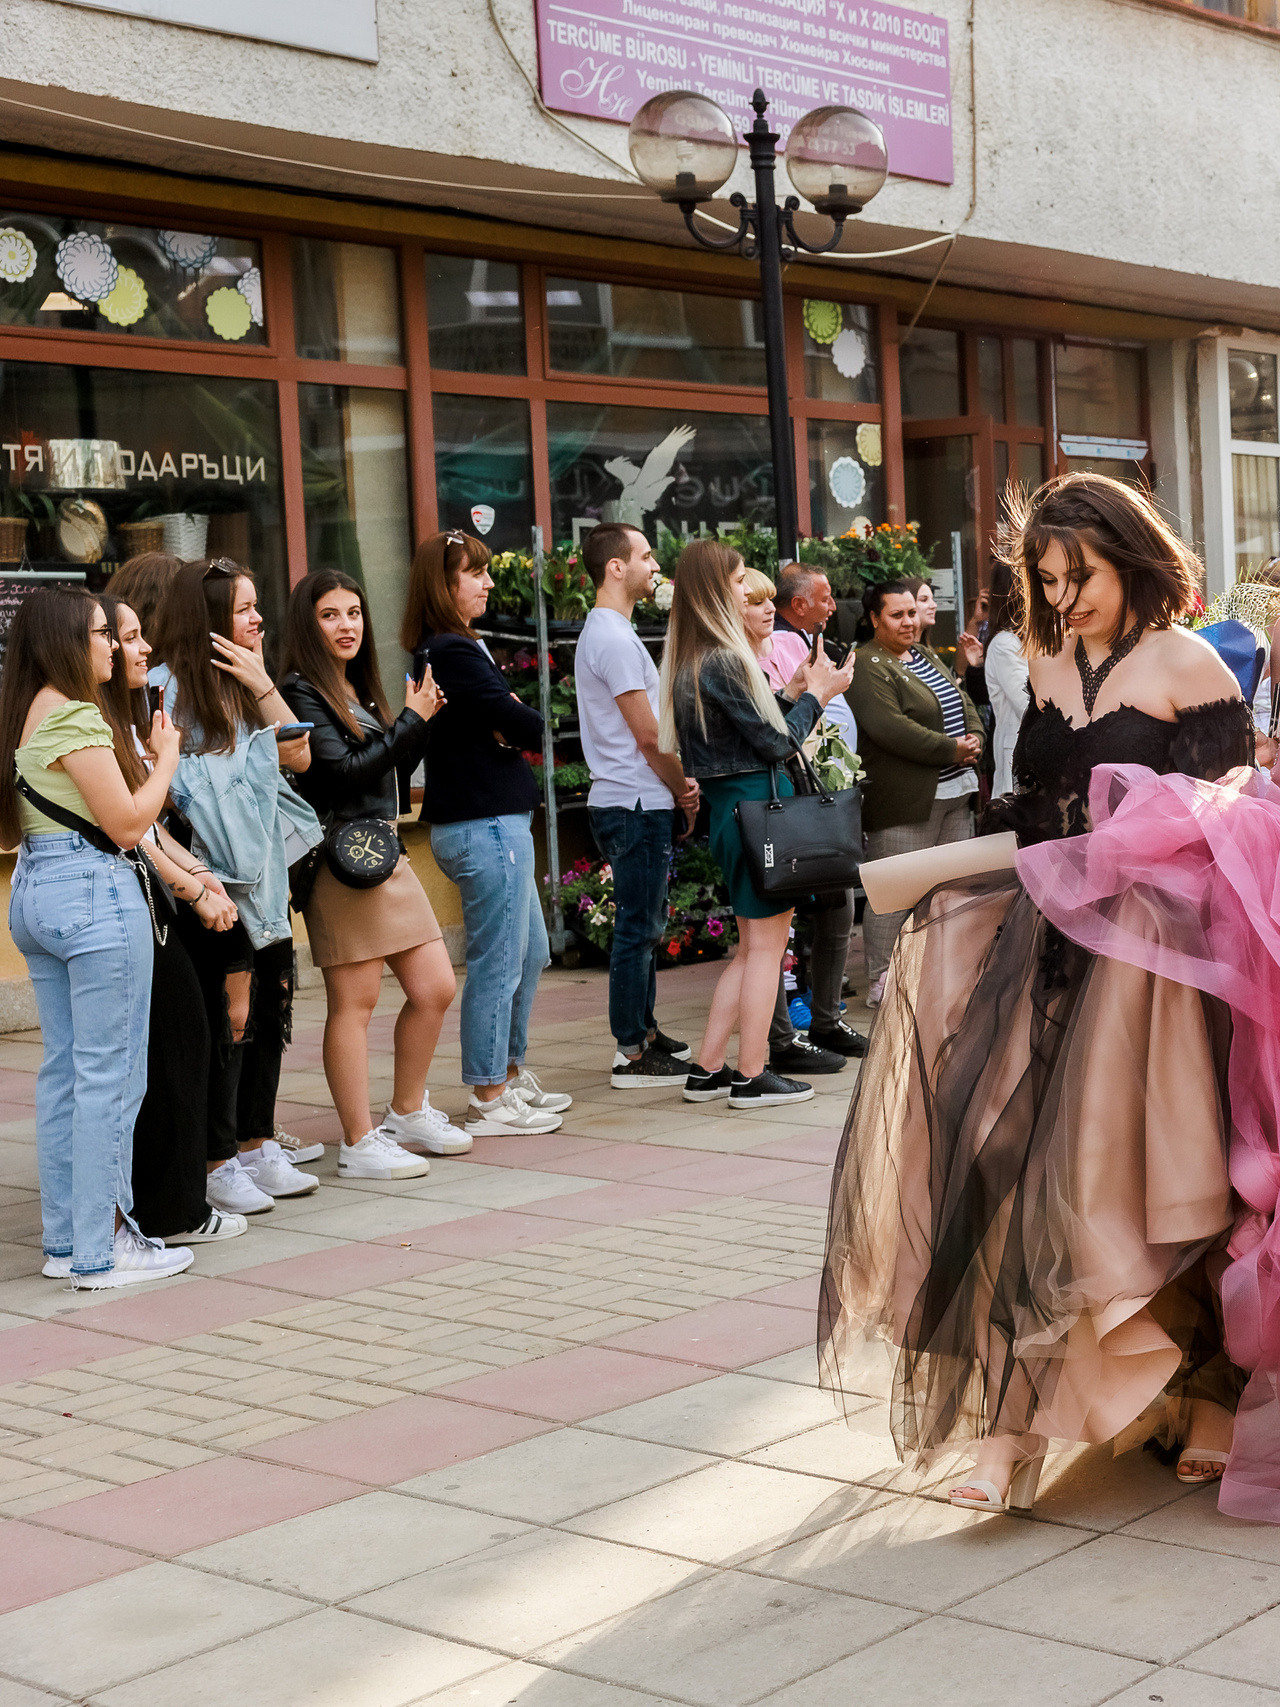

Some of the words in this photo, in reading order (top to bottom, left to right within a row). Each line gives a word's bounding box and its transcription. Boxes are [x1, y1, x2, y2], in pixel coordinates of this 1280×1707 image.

[622, 0, 710, 32] Лицензиран
[713, 21, 777, 48] преводач
[780, 34, 840, 64] Хюмейра
[723, 3, 801, 33] легализация
[803, 22, 827, 39] във
[829, 28, 869, 50] всички
[871, 39, 947, 69] министерства
[872, 11, 901, 37] 2010
[546, 19, 623, 57] TERCÜME
[625, 31, 687, 71] BÜROSU
[698, 51, 754, 86] YEMİNLİ
[756, 65, 821, 100] TERCÜME
[822, 79, 841, 104] VE
[842, 83, 887, 115] TASDİK
[888, 89, 950, 127] İŞLEMLERİ
[0, 443, 44, 473] ТЯ
